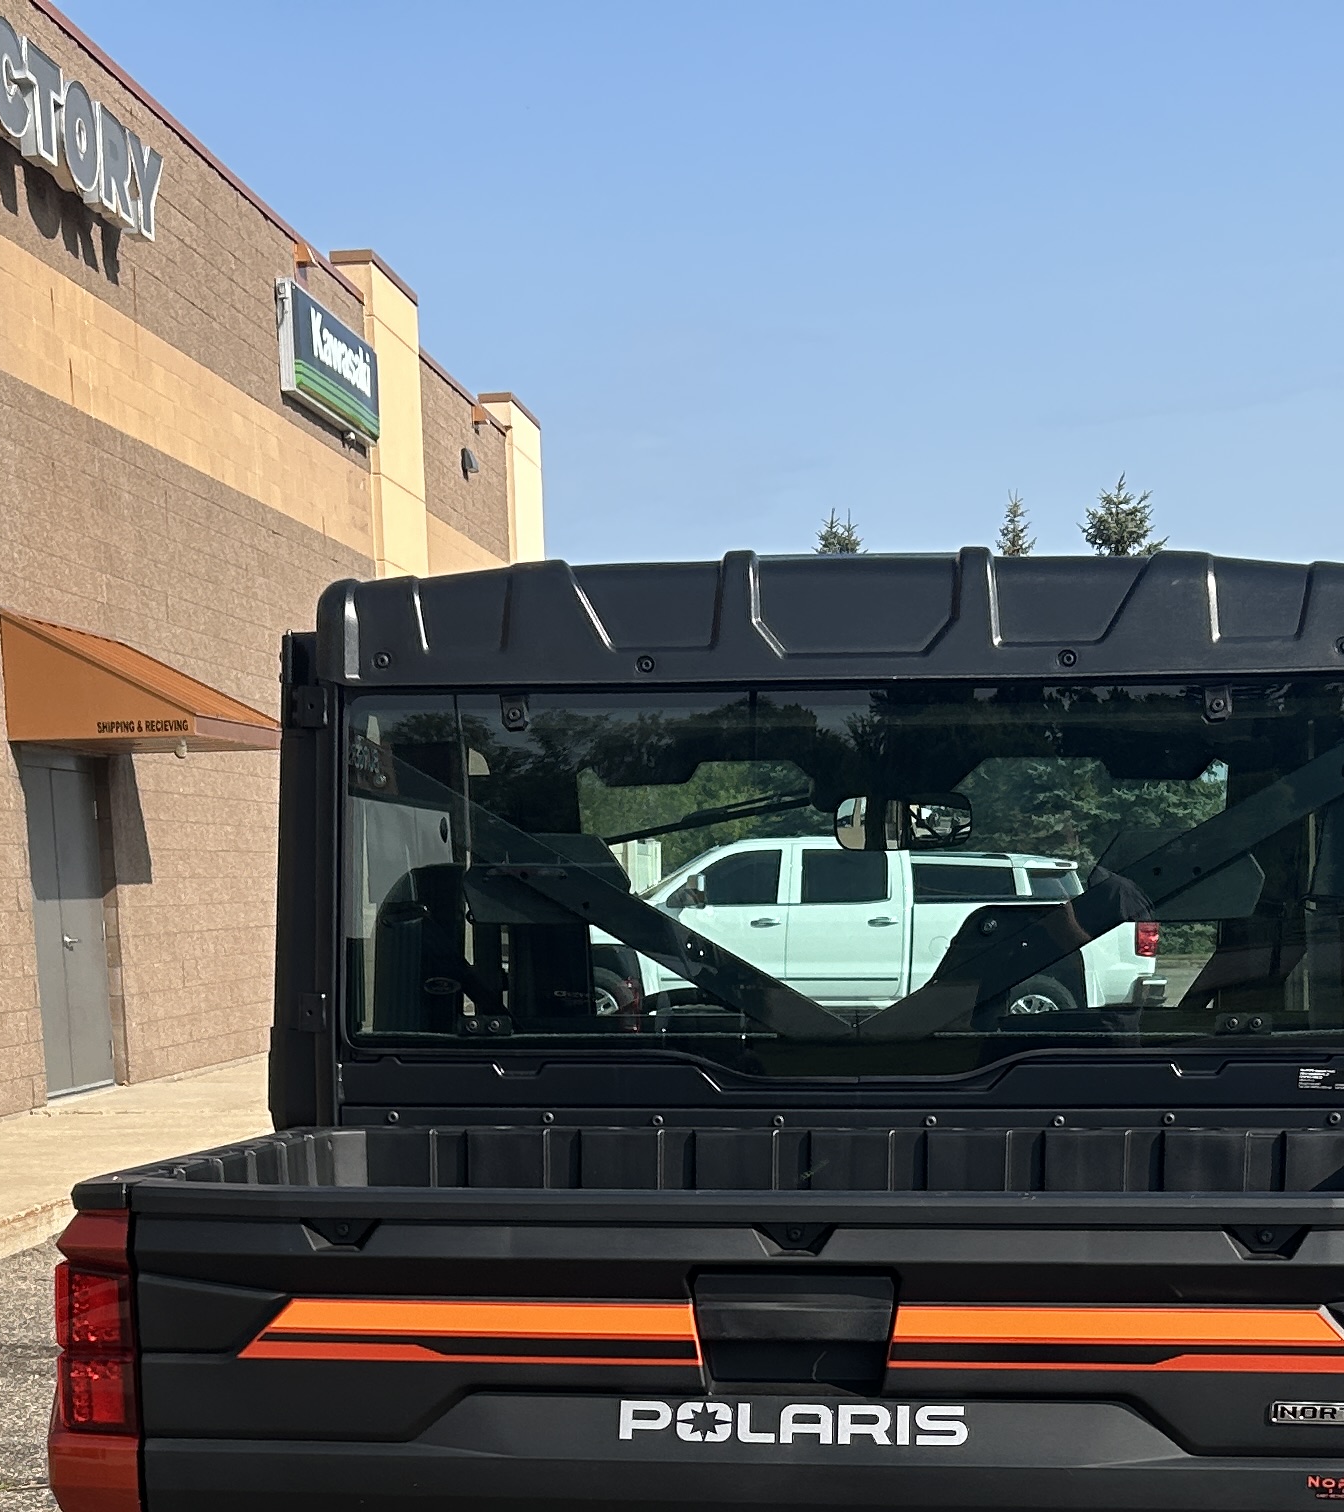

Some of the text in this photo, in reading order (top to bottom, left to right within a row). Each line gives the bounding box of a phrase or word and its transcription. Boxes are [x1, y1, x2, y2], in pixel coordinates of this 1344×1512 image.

[310, 305, 372, 399] Kawasaki
[97, 719, 188, 733] SHIPPING & RECIEVING
[618, 1399, 970, 1447] POLARIS
